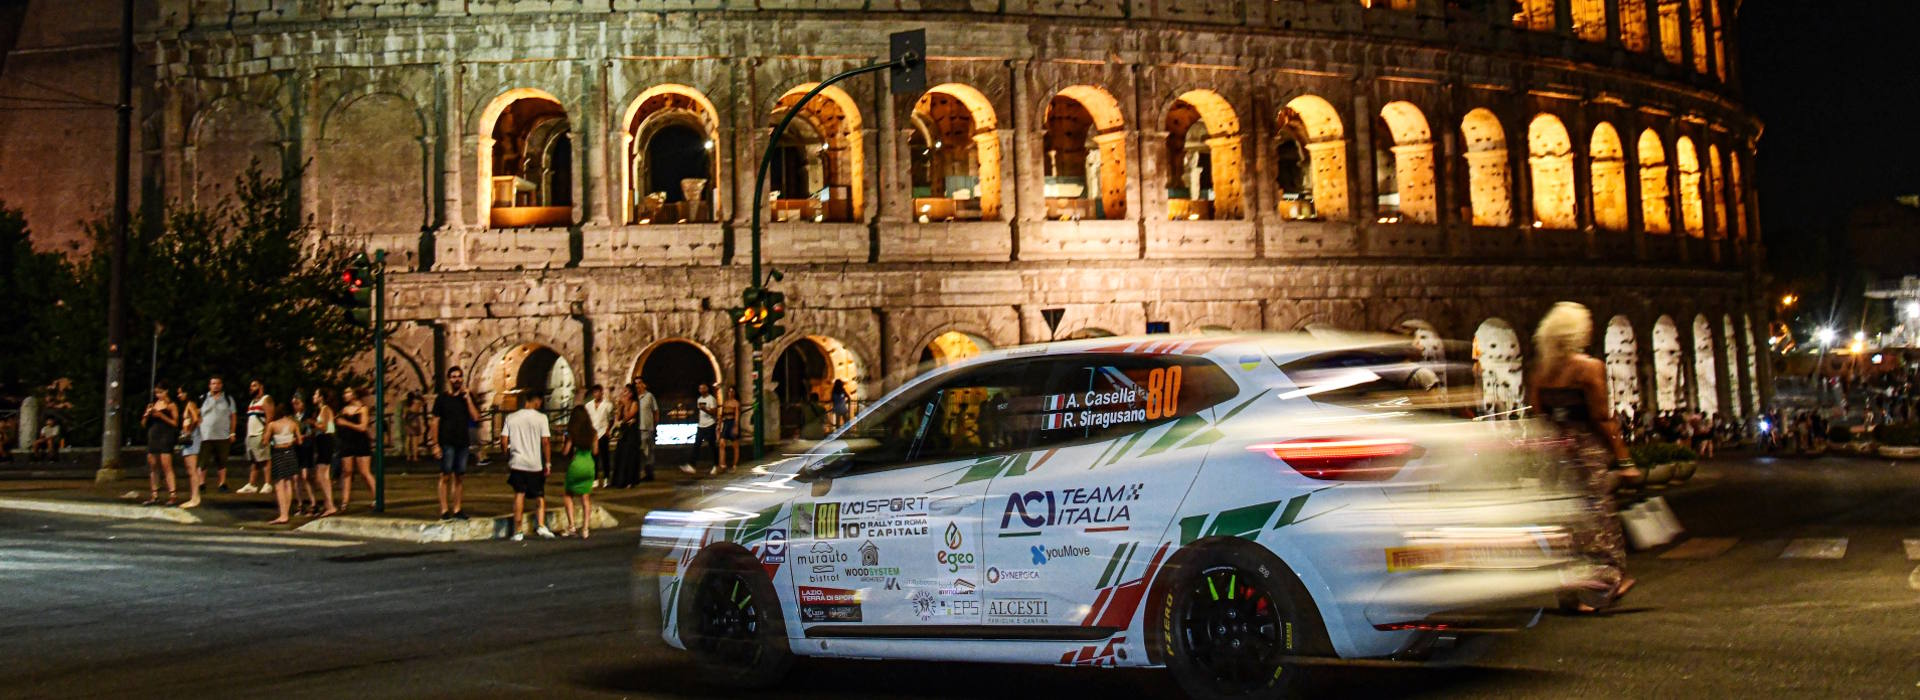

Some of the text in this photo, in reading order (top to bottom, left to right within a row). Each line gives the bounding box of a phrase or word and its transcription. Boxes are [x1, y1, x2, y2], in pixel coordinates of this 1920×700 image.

[1066, 388, 1136, 408] A. Casella
[1146, 365, 1182, 420] 80
[1063, 407, 1146, 429] R. Siragusano
[1062, 485, 1123, 505] TEAM
[1000, 490, 1056, 529] ACI
[1058, 505, 1131, 525] ITALIA
[817, 503, 838, 539] 80
[904, 518, 928, 526] ROMA
[868, 527, 928, 538] CAPITALE
[797, 550, 848, 565] murauto
[937, 550, 974, 573] egeo
[1046, 545, 1091, 561] youMove
[809, 573, 841, 583] bistrot
[954, 601, 980, 616] EPS
[988, 601, 1049, 615] ALCESTI
